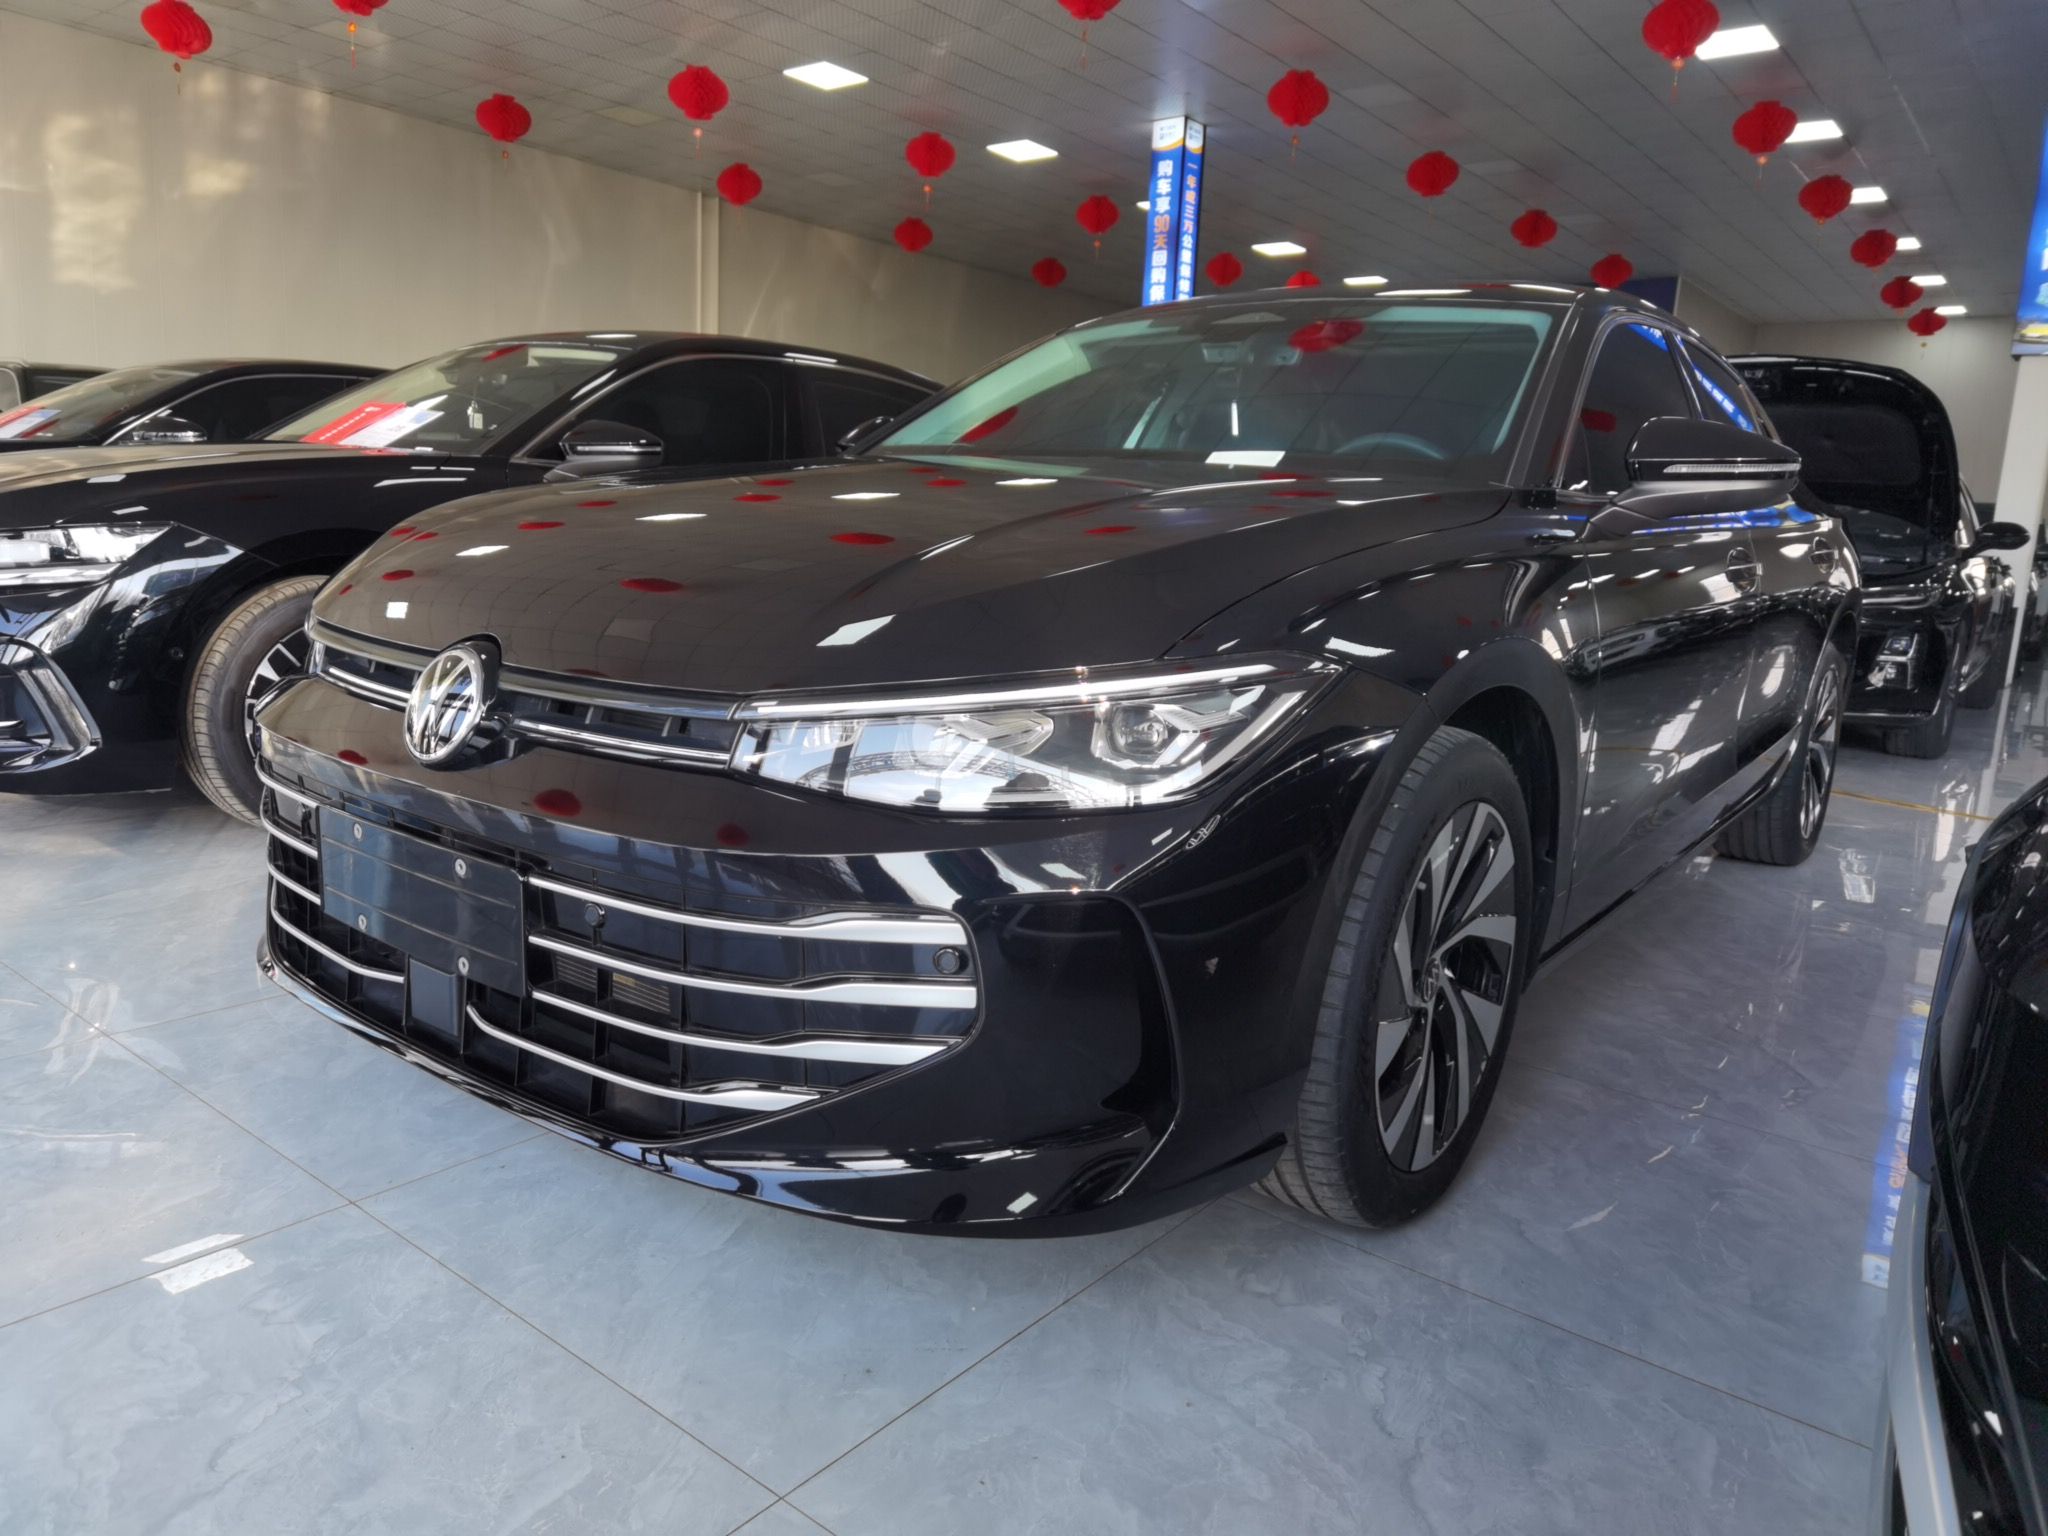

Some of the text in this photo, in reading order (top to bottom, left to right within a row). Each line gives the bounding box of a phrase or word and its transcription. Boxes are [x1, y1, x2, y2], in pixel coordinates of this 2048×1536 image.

[1149, 159, 1174, 304] 购车享90天回购保
